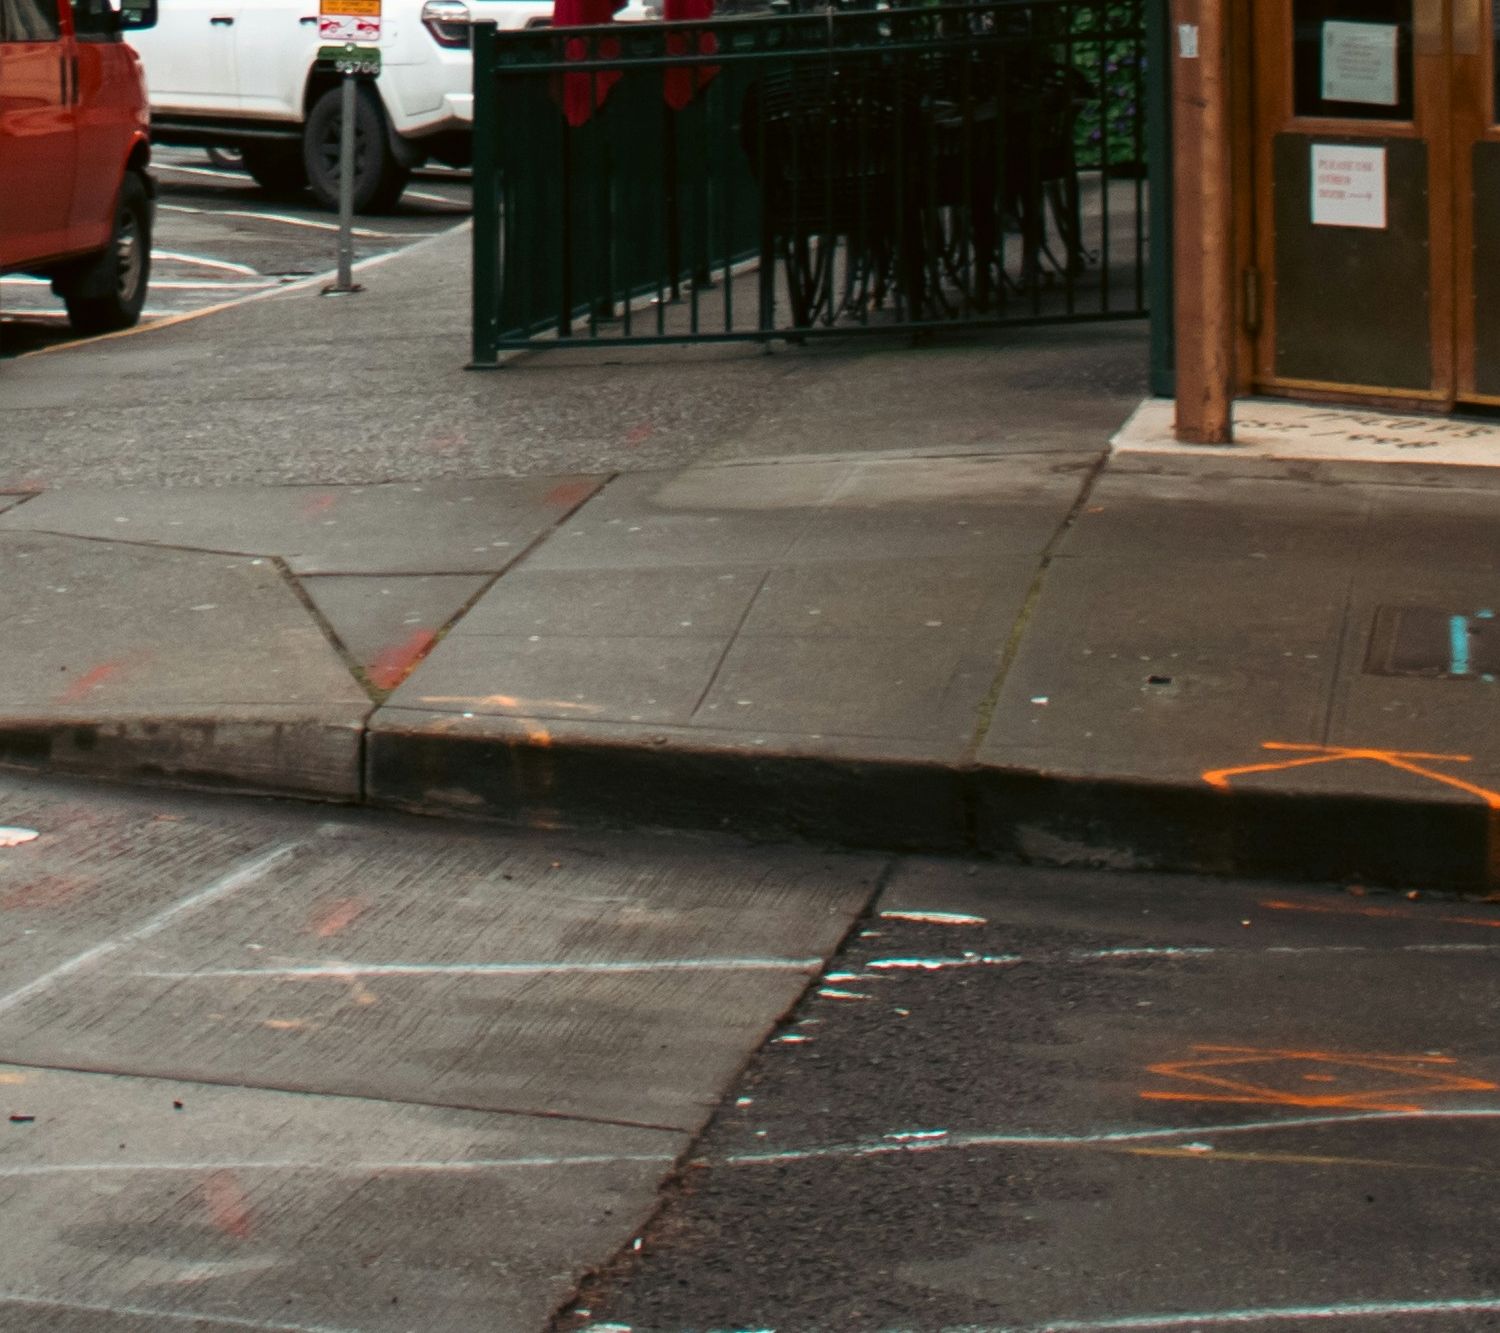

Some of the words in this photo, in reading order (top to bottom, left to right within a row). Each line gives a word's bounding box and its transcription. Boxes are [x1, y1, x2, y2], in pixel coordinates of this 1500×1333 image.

[335, 60, 381, 75] 95706
[1318, 159, 1354, 171] PLEASE
[1318, 174, 1352, 184] OTHER
[1318, 189, 1347, 200] DOOR
